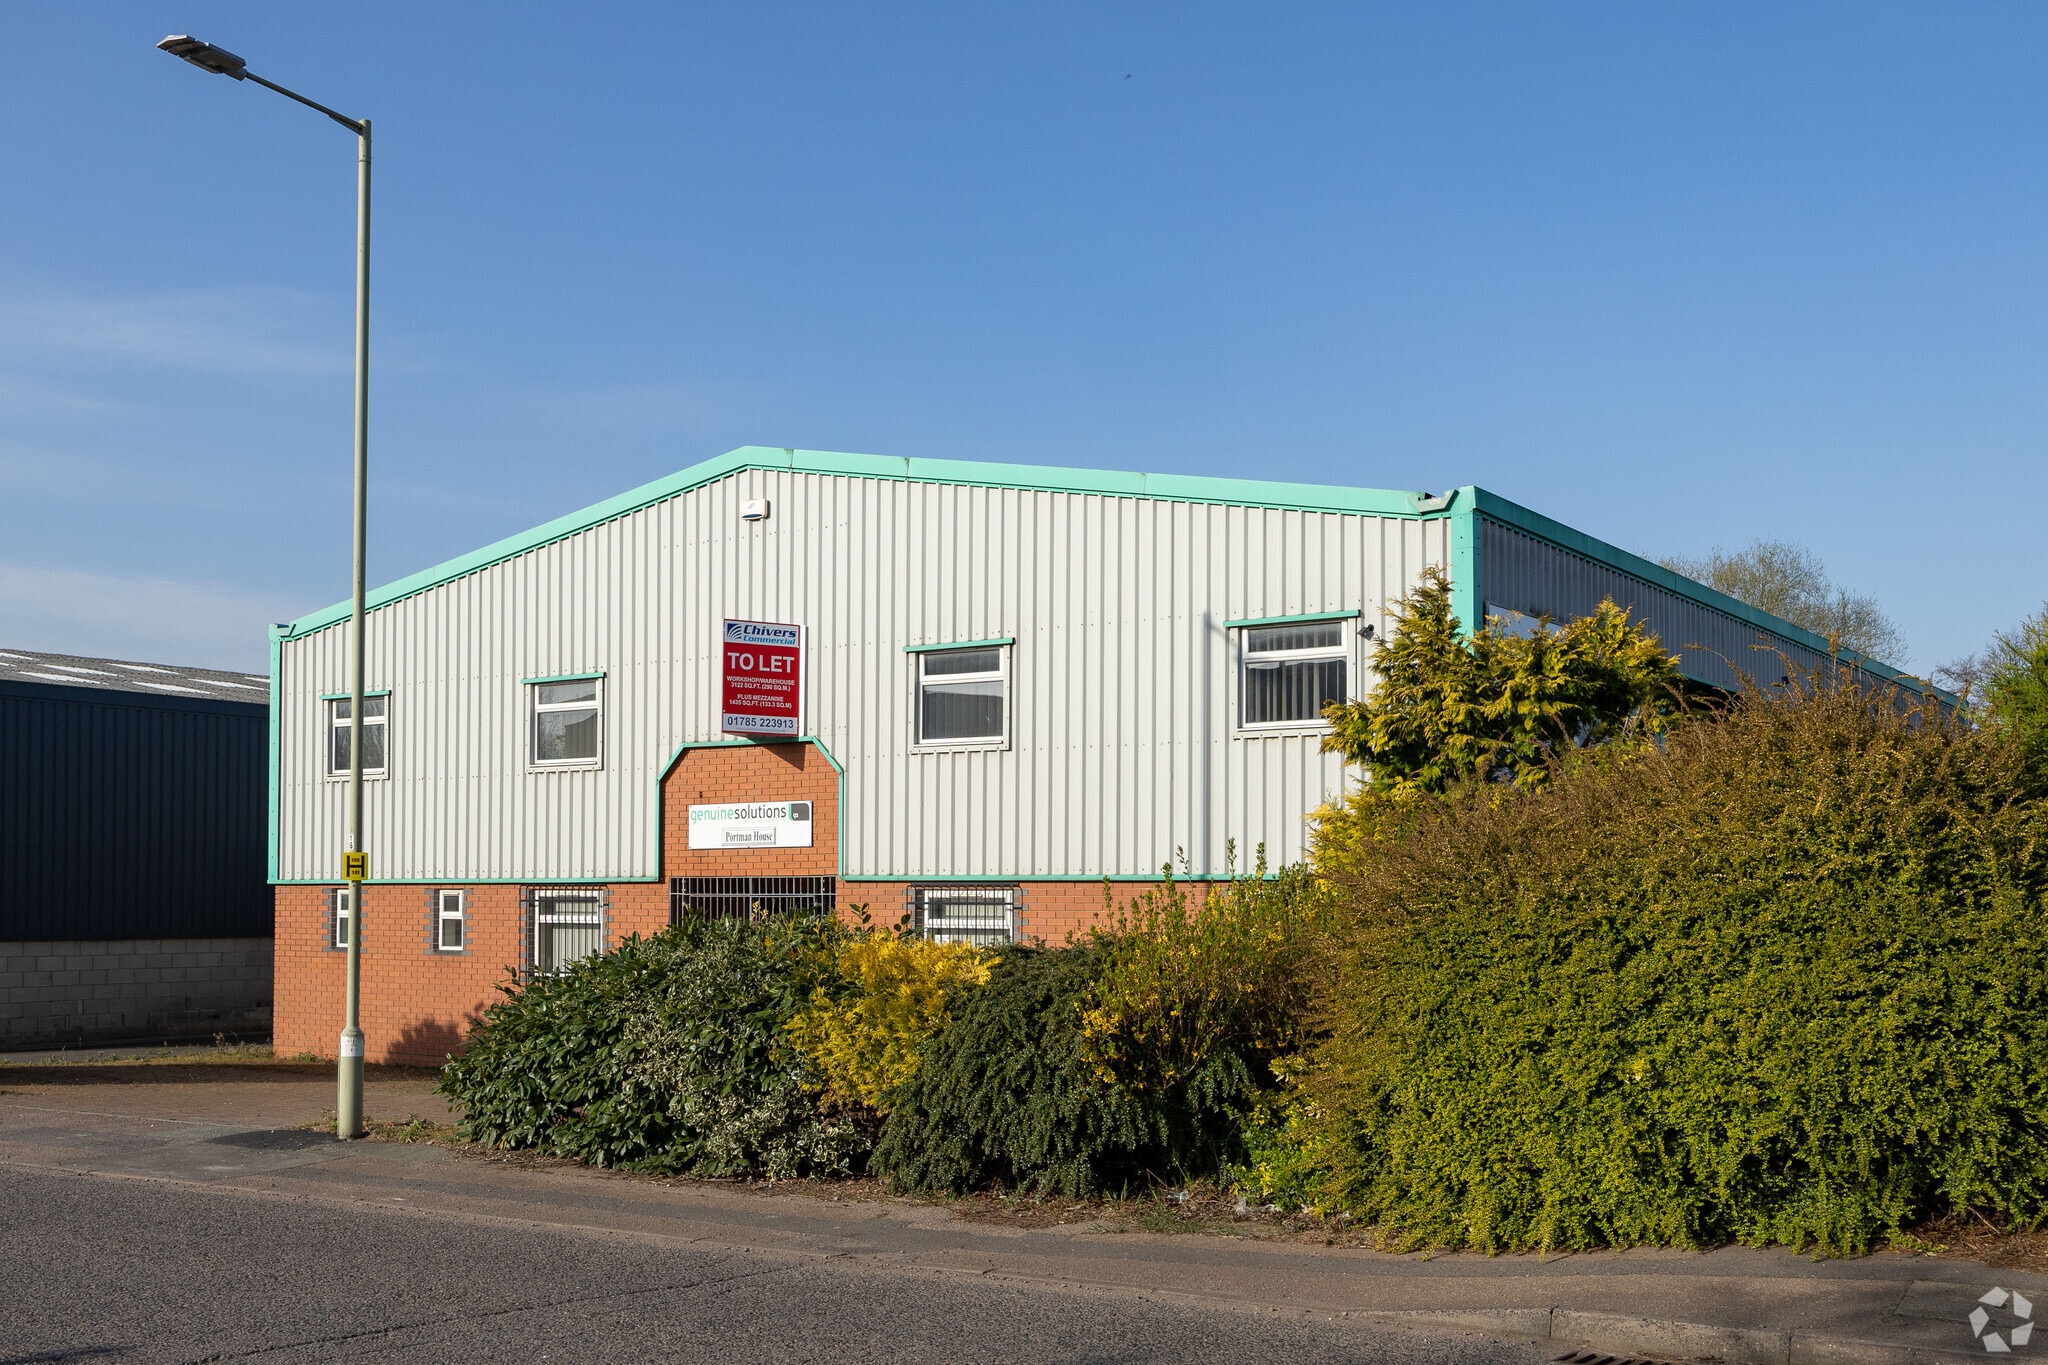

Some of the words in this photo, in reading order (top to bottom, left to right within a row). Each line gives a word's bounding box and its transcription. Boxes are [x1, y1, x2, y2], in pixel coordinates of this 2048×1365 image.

[743, 624, 796, 638] Chivers
[743, 635, 796, 645] Commercial
[727, 651, 754, 671] TO
[759, 654, 795, 673] LET
[753, 694, 784, 702] MEZZANINE
[727, 716, 757, 727] 01785
[759, 717, 794, 729] 223913
[690, 804, 787, 825] genuinesolutions
[725, 831, 752, 842] Portman
[753, 830, 773, 841] House
